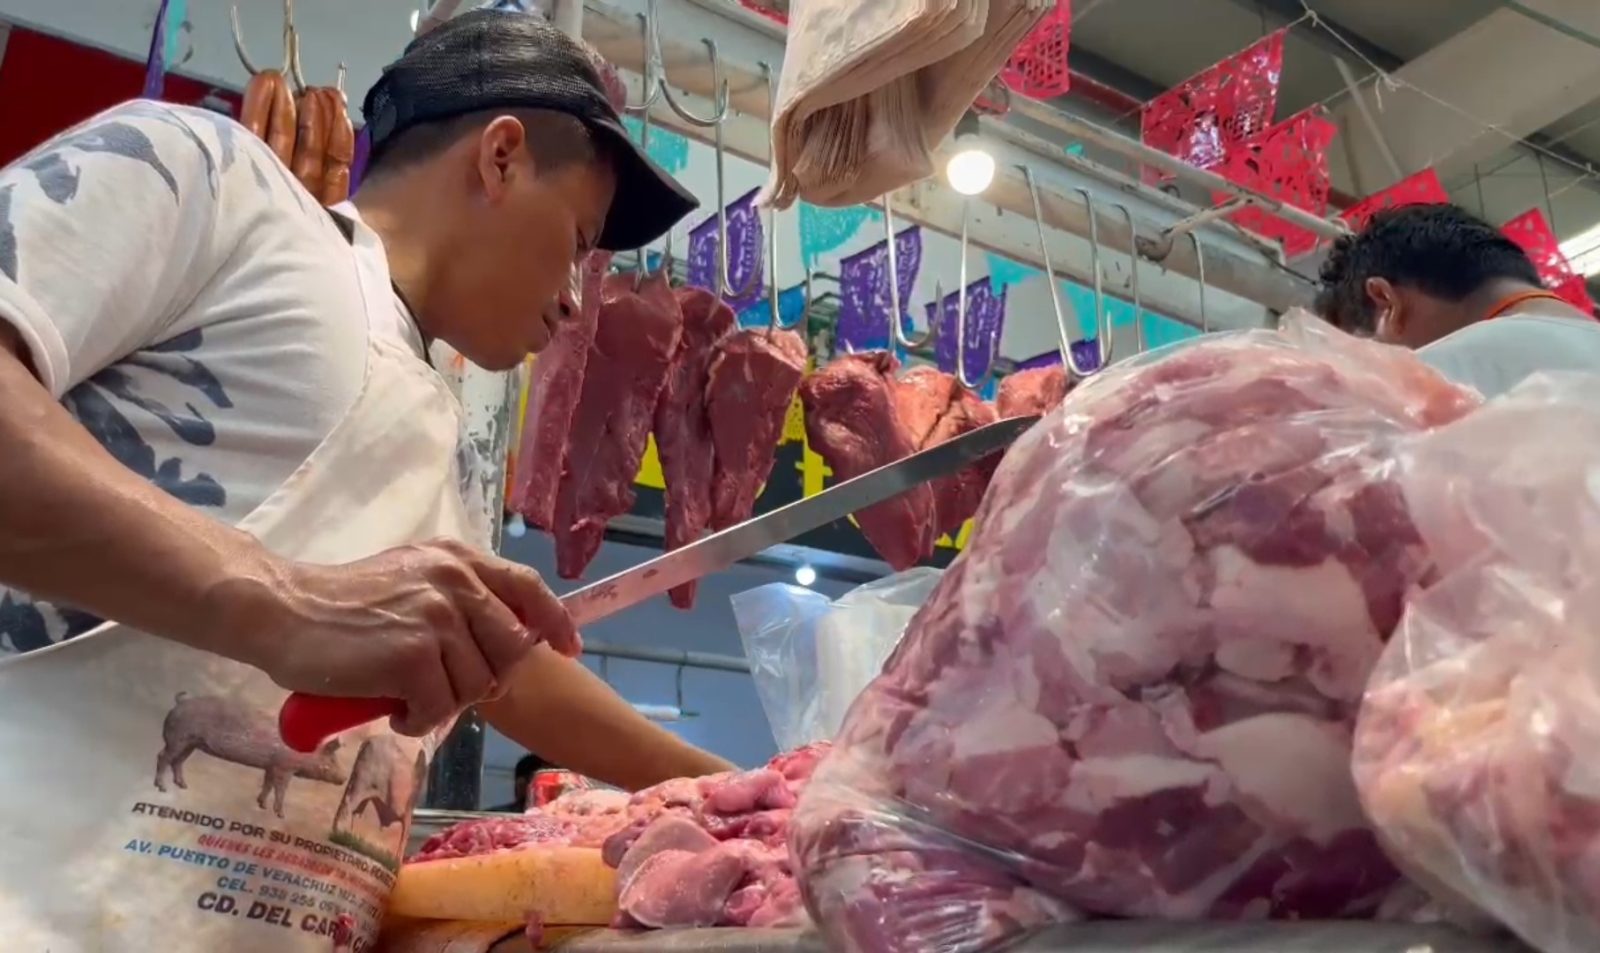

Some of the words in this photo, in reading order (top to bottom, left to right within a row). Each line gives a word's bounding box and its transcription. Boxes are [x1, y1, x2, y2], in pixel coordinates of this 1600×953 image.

[132, 802, 224, 830] ATENDIDO
[229, 821, 265, 838] POR
[270, 830, 291, 845] SU
[124, 839, 152, 854] AV.
[158, 844, 230, 870] PUERTO
[233, 861, 258, 876] DE
[262, 866, 336, 895] VERACRUZ
[217, 876, 253, 893] CEL.
[197, 892, 239, 916] CD.
[247, 901, 292, 928] DEL
